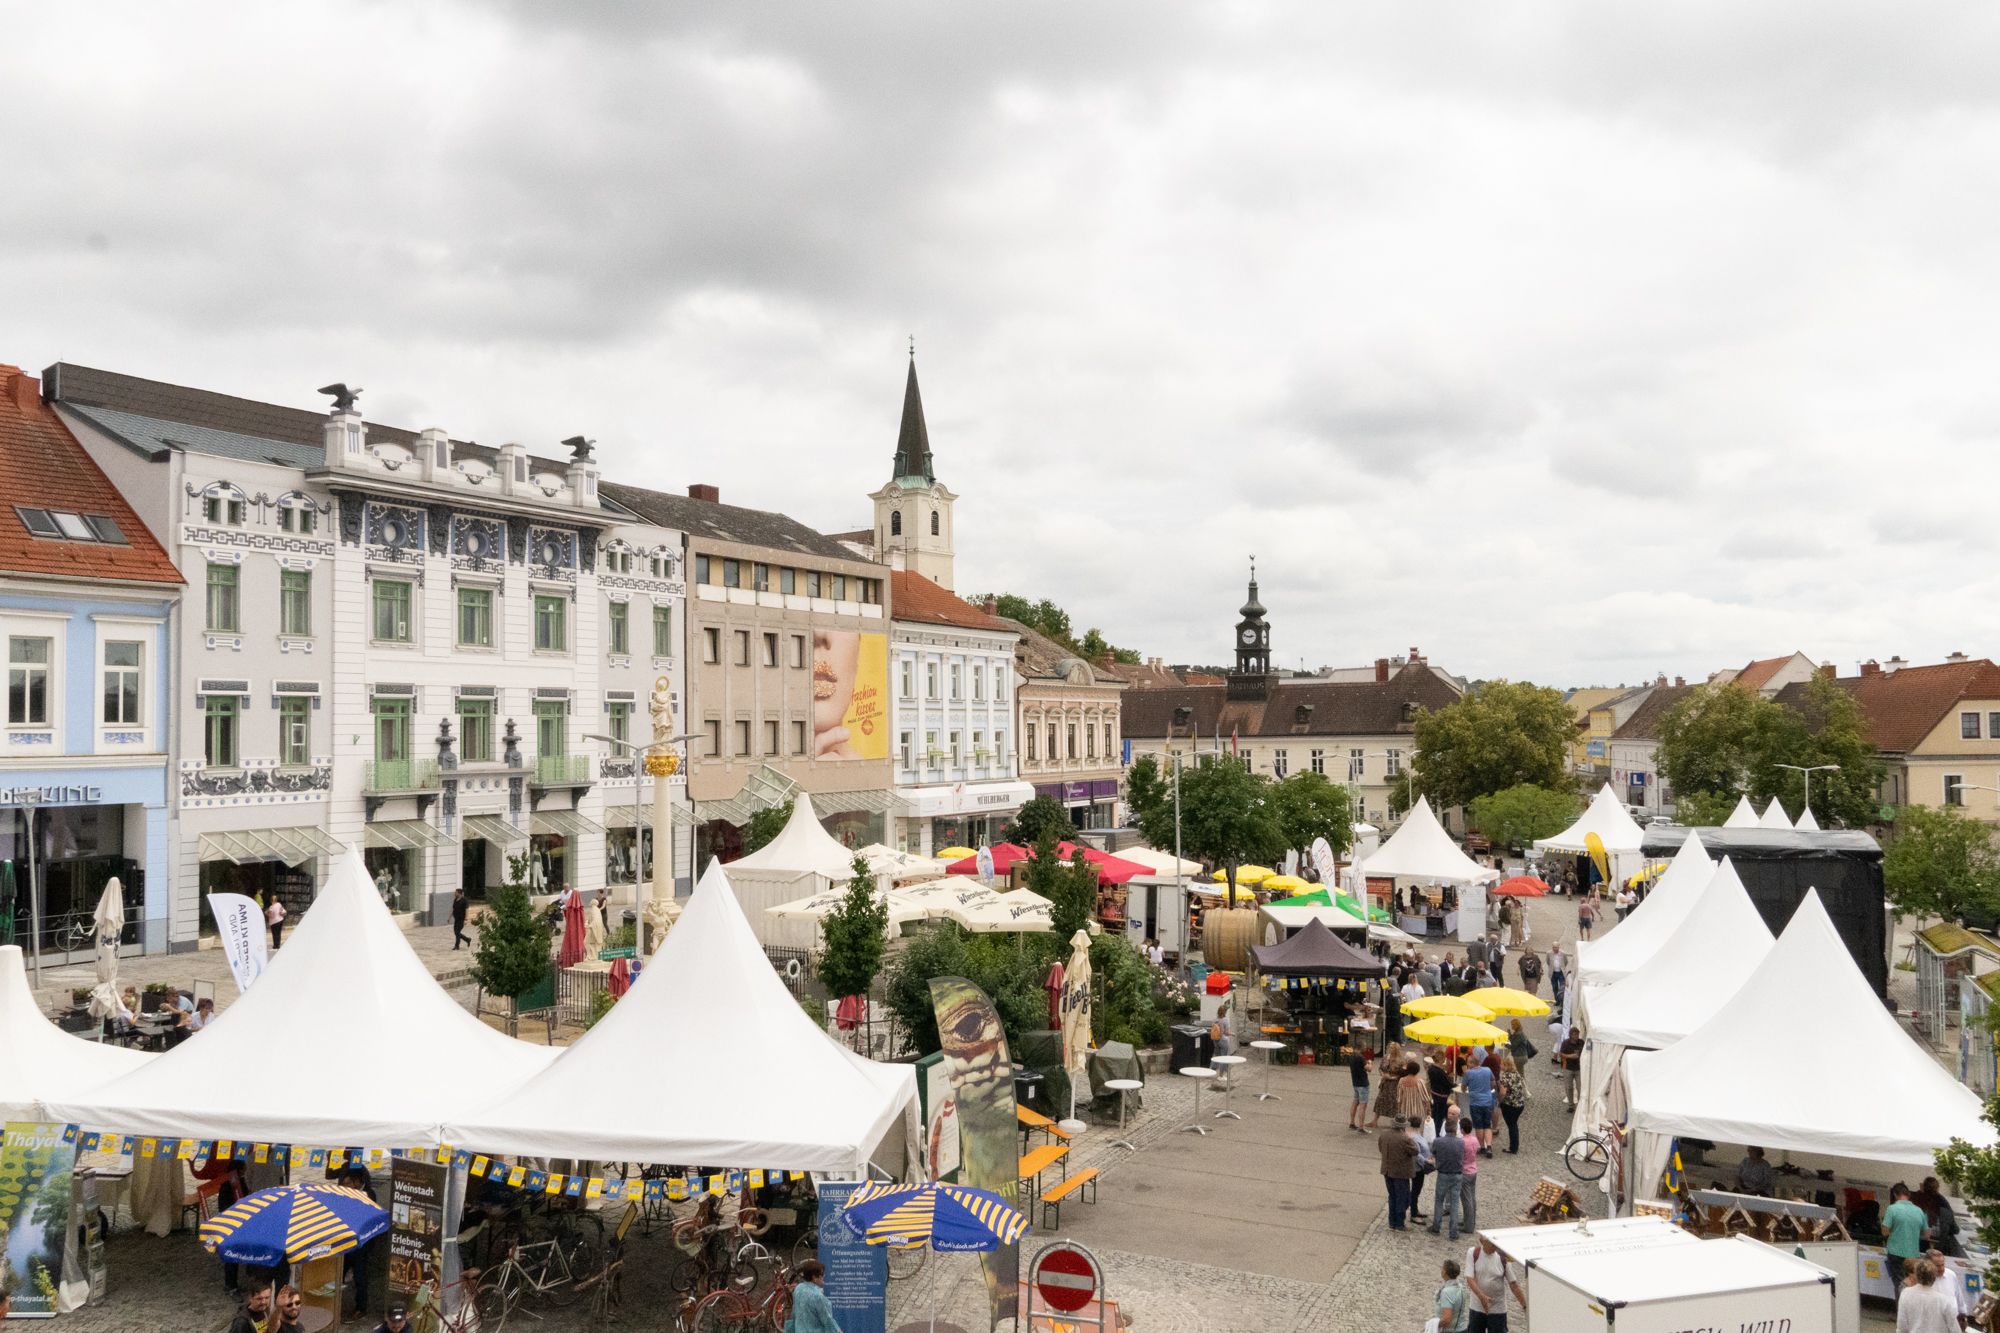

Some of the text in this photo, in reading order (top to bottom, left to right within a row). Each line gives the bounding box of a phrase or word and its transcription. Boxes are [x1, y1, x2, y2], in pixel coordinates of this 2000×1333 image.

[395, 1181, 434, 1197] Weinstadt
[394, 1192, 412, 1203] Retz
[391, 1234, 425, 1249] Erlebnis-
[391, 1244, 431, 1260] keller Retz
